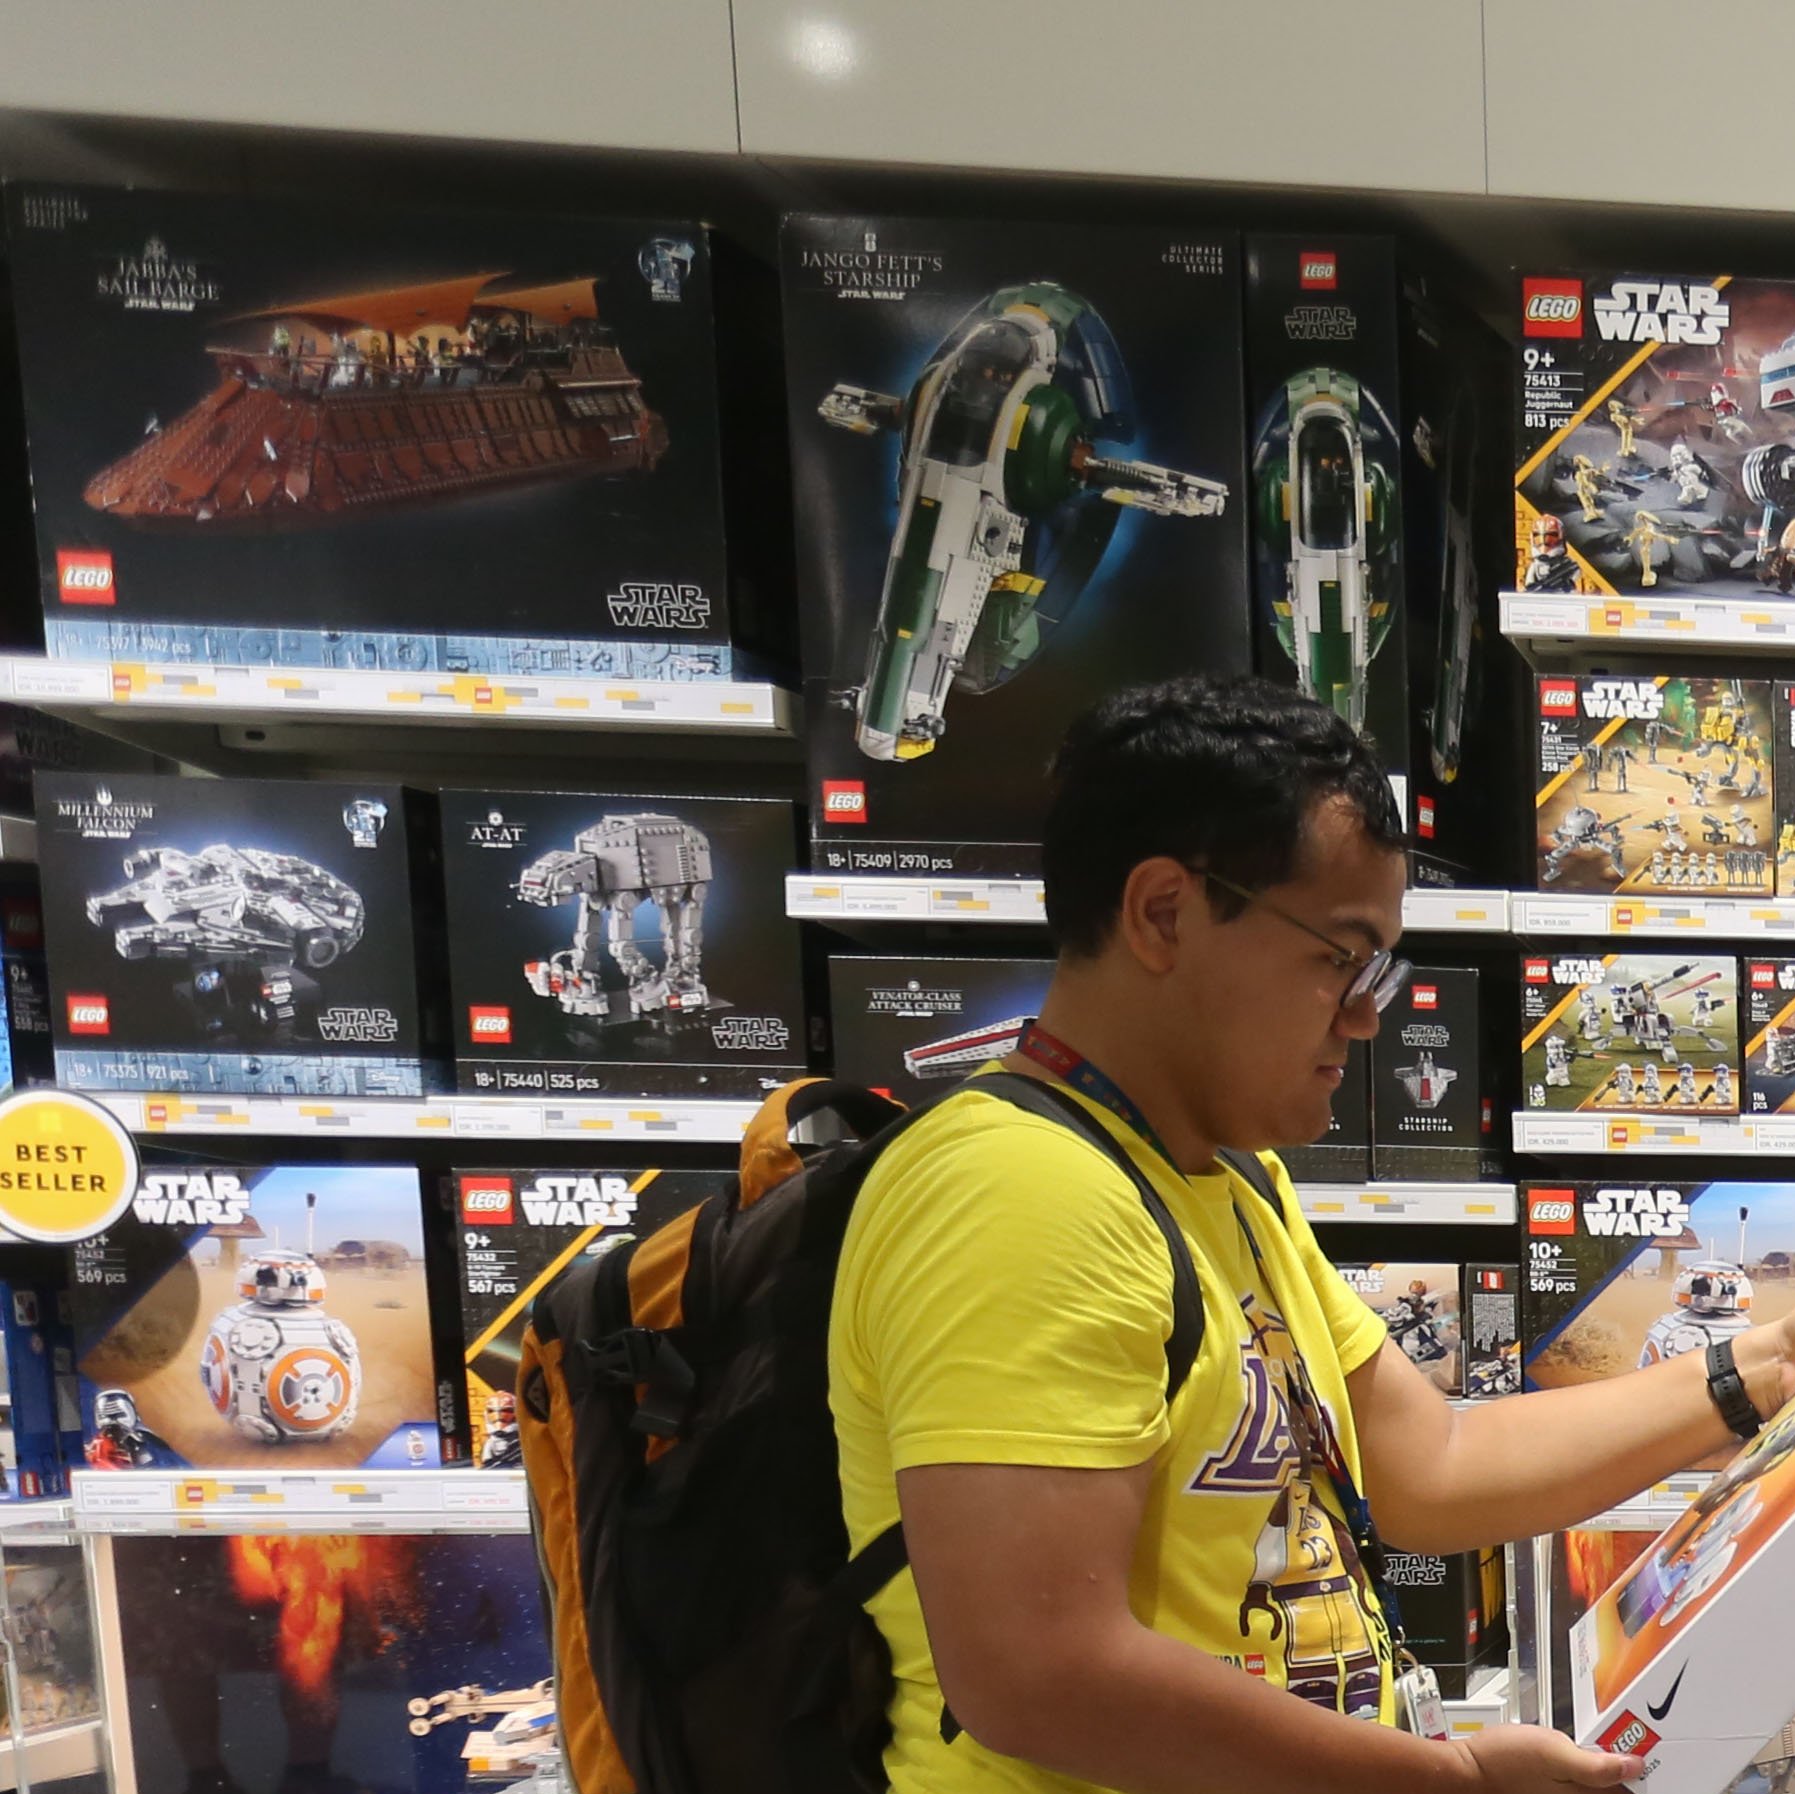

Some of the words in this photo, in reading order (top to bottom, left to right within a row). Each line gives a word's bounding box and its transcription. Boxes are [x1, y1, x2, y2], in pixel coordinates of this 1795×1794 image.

[1161, 254, 1223, 264] COLLECTOR
[1170, 246, 1223, 255] ULTIMATE
[119, 257, 197, 281] JABBA'S
[801, 252, 870, 267] JANGO
[878, 255, 943, 272] FETT'S
[1185, 265, 1223, 274] SERIES
[824, 271, 920, 288] STARSHIP
[1303, 263, 1336, 280] LEGO
[97, 274, 145, 297] SAIL
[151, 280, 219, 301] BARGE
[838, 290, 871, 298] STAR
[872, 291, 906, 300] WARS
[1594, 282, 1729, 315] STAR
[1284, 306, 1356, 323] STAR
[1526, 295, 1580, 321] LEGO
[1285, 321, 1356, 340] WARS
[1594, 311, 1730, 346] WARS
[1524, 349, 1555, 371] 9+
[1524, 375, 1561, 387] 75413
[1525, 391, 1561, 400] Republic
[1525, 400, 1573, 410] Juggernaut
[1525, 414, 1546, 428] 813
[1550, 416, 1570, 430] pcs
[62, 565, 113, 590] LEGO
[607, 583, 710, 606] STAR
[608, 604, 710, 629] WARS
[1542, 690, 1576, 707] LEGO
[1582, 682, 1664, 702] STAR
[1582, 699, 1664, 719] WARS
[1541, 721, 1559, 735] 7+
[1541, 762, 1558, 773] 258
[826, 792, 865, 811] LEGO
[58, 804, 154, 820] MILLENNIUM
[77, 816, 137, 831] FALCON
[471, 826, 522, 841] AT-AT
[827, 853, 846, 868] 18+
[853, 853, 892, 869] 75409
[900, 854, 930, 869] 2970
[932, 857, 953, 871] pcs
[1526, 966, 1548, 976] LEGO
[1552, 960, 1605, 973] STAR
[1552, 971, 1605, 984] WARS
[1752, 971, 1774, 982] LEGO
[872, 992, 962, 1002] VENATOR-CLASS
[1525, 988, 1540, 997] 6+
[1751, 993, 1764, 1001] 6+
[868, 1001, 914, 1010] ATTACK
[915, 1002, 962, 1011] CRUISER
[71, 1006, 108, 1024] LEGO
[318, 1008, 397, 1026] STAR
[319, 1022, 397, 1042] WARS
[473, 1016, 509, 1033] LEGO
[712, 1017, 788, 1034] STAR
[1401, 1025, 1449, 1037] STAR
[713, 1031, 788, 1050] WARS
[1401, 1034, 1449, 1046] WARS
[74, 1064, 92, 1077] 18+
[103, 1065, 138, 1079] 75375
[147, 1066, 166, 1080] 921
[170, 1070, 189, 1082] pcs
[475, 1072, 495, 1087] 18+
[502, 1073, 543, 1088] 75440
[550, 1074, 574, 1089] 525
[576, 1076, 599, 1091] pcs
[1752, 1092, 1765, 1101] 116
[1752, 1100, 1768, 1110] pcs
[1398, 1124, 1453, 1132] COLLECTION
[16, 1144, 88, 1164] BEST
[0, 1171, 107, 1193] SELLER
[137, 1174, 249, 1201] STAR
[521, 1178, 637, 1202] STAR
[464, 1190, 511, 1212] LEGO
[1583, 1190, 1689, 1213] STAR
[132, 1199, 249, 1226] WARS
[521, 1201, 637, 1226] WARS
[1530, 1202, 1574, 1222] LEGO
[1583, 1212, 1689, 1236] WARS
[464, 1232, 491, 1250] 9+
[466, 1253, 496, 1262] 75432
[1529, 1242, 1562, 1259] 10+
[1529, 1261, 1558, 1269] 75452
[78, 1270, 102, 1284] 569
[105, 1272, 127, 1285] pcs
[468, 1280, 493, 1294] 567
[494, 1282, 516, 1296] pcs
[1530, 1279, 1554, 1292] 569
[1556, 1281, 1576, 1294] pcs
